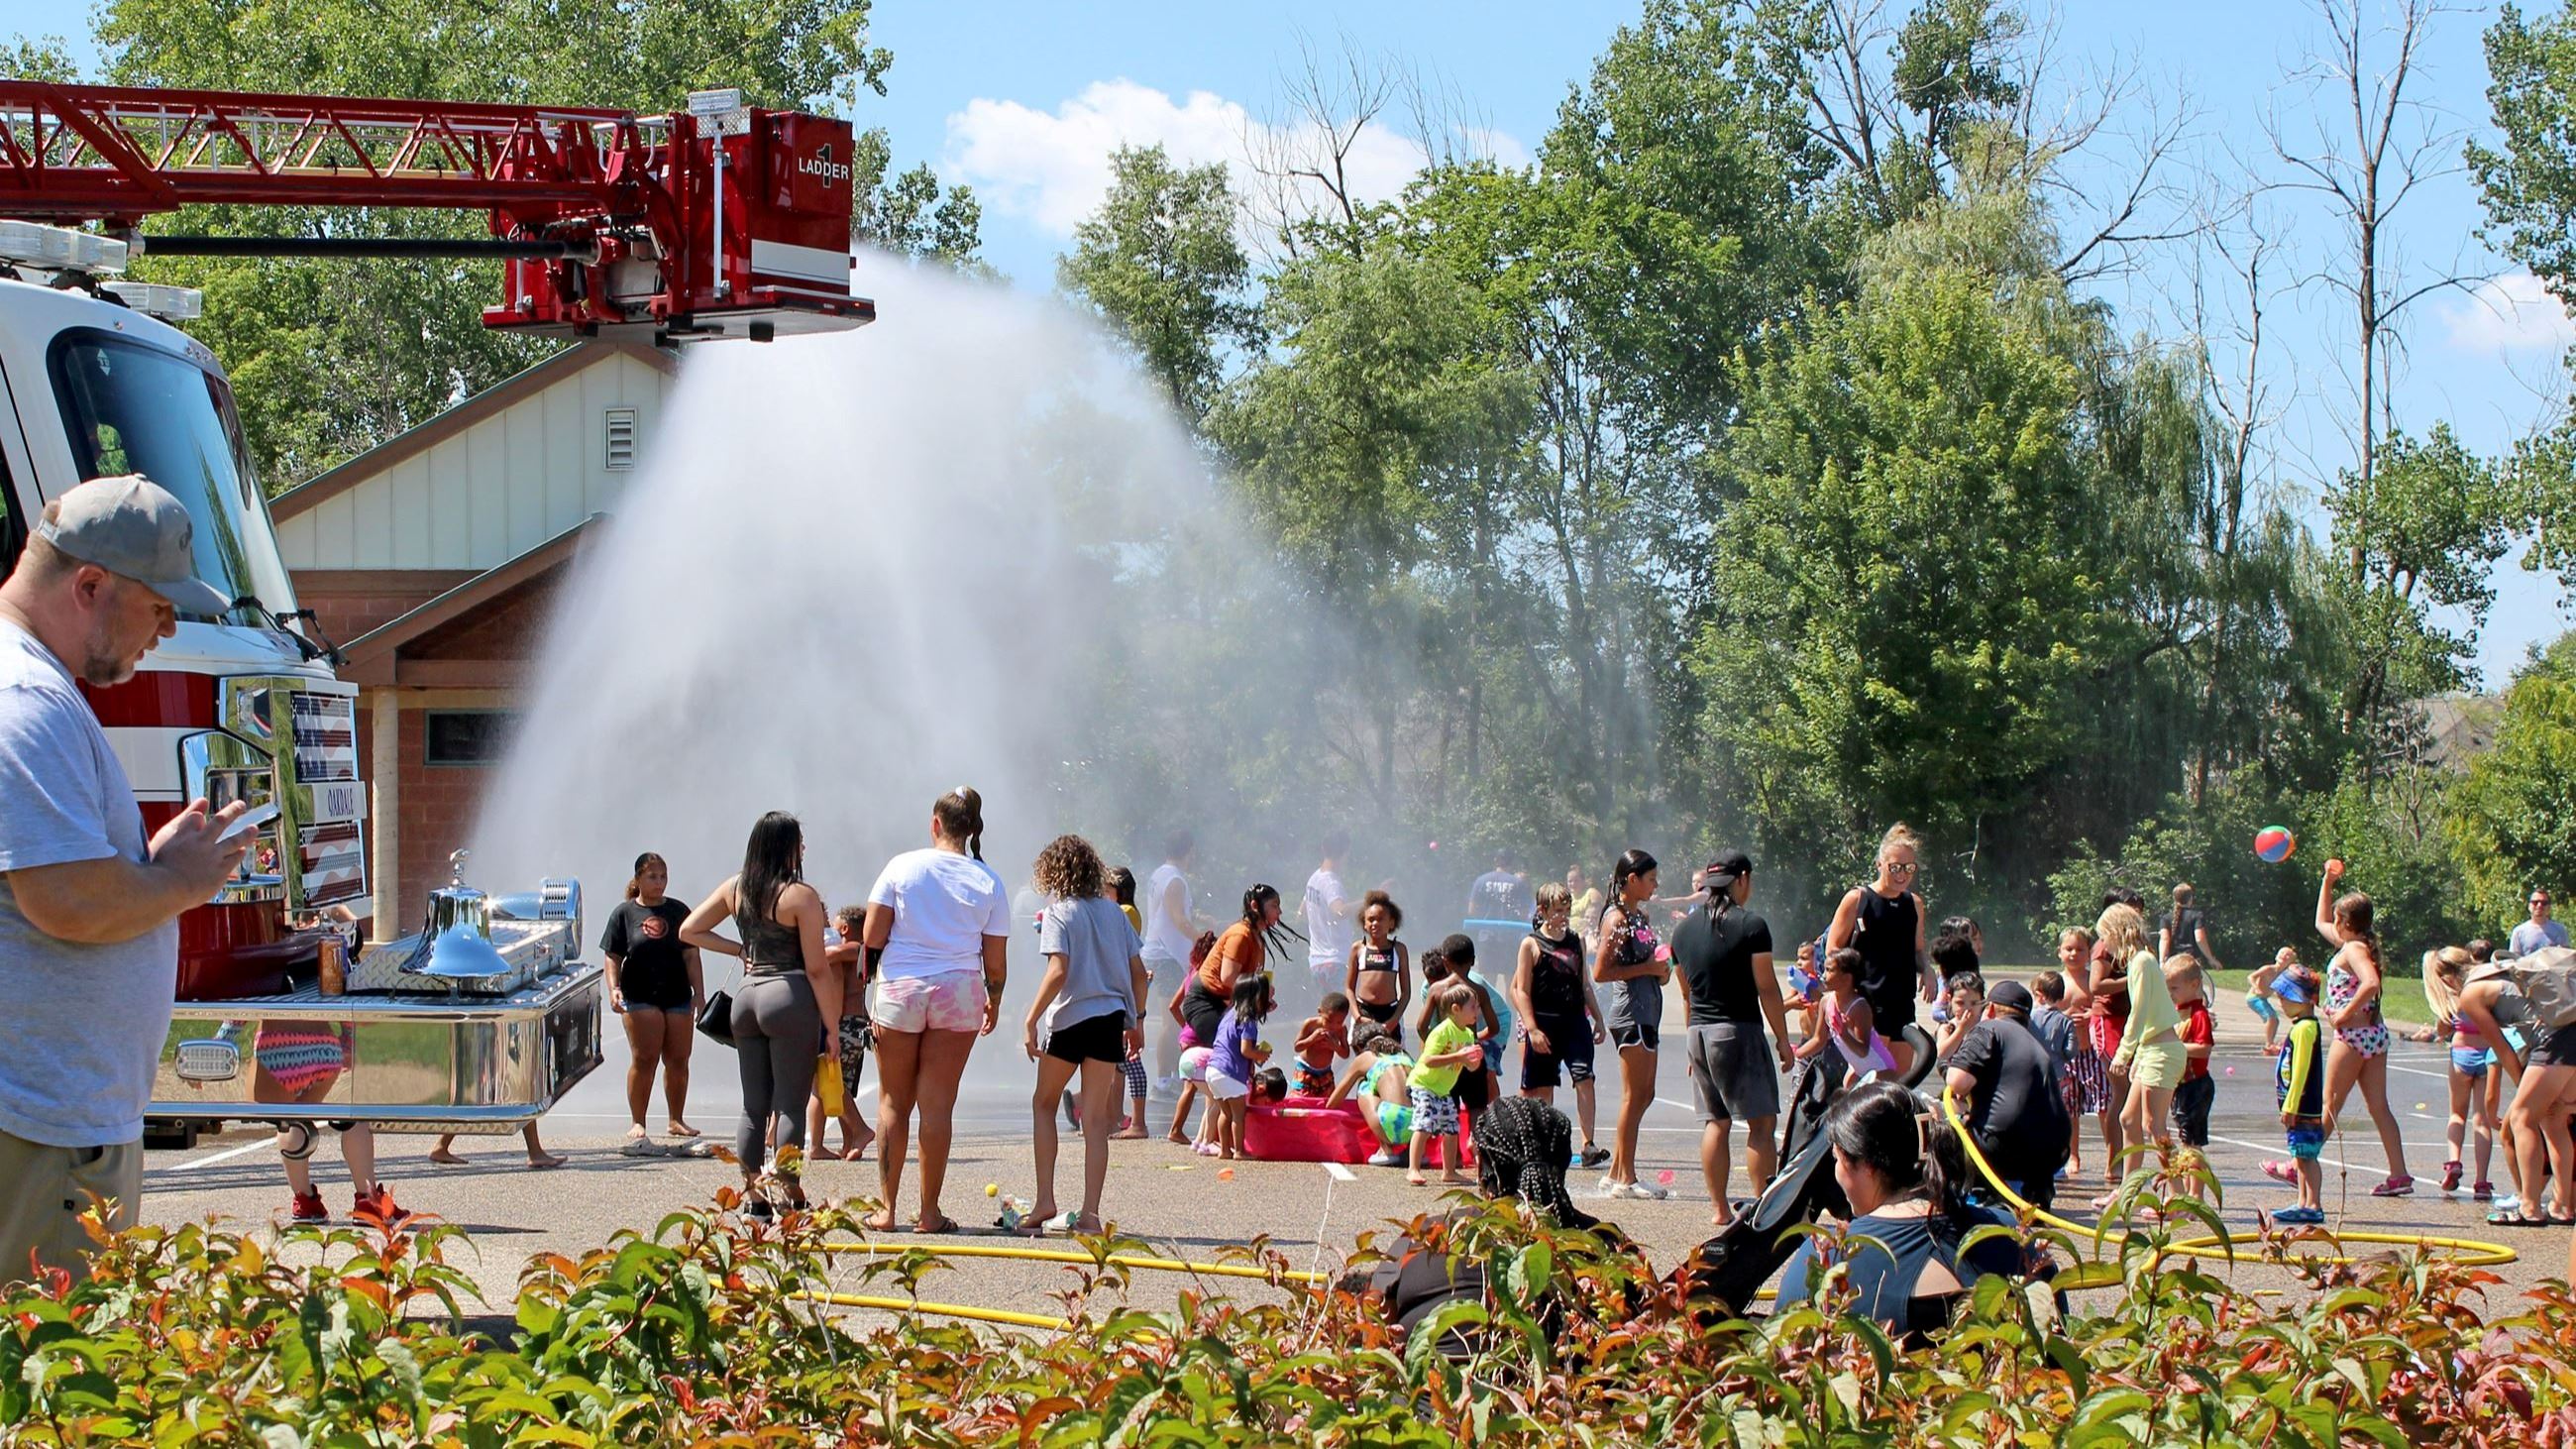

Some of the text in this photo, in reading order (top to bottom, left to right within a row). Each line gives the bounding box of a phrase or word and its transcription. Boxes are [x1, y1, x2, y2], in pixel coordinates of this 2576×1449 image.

[799, 157, 849, 180] LADDER
[816, 143, 831, 188] 1
[327, 787, 354, 817] OAKDALE
